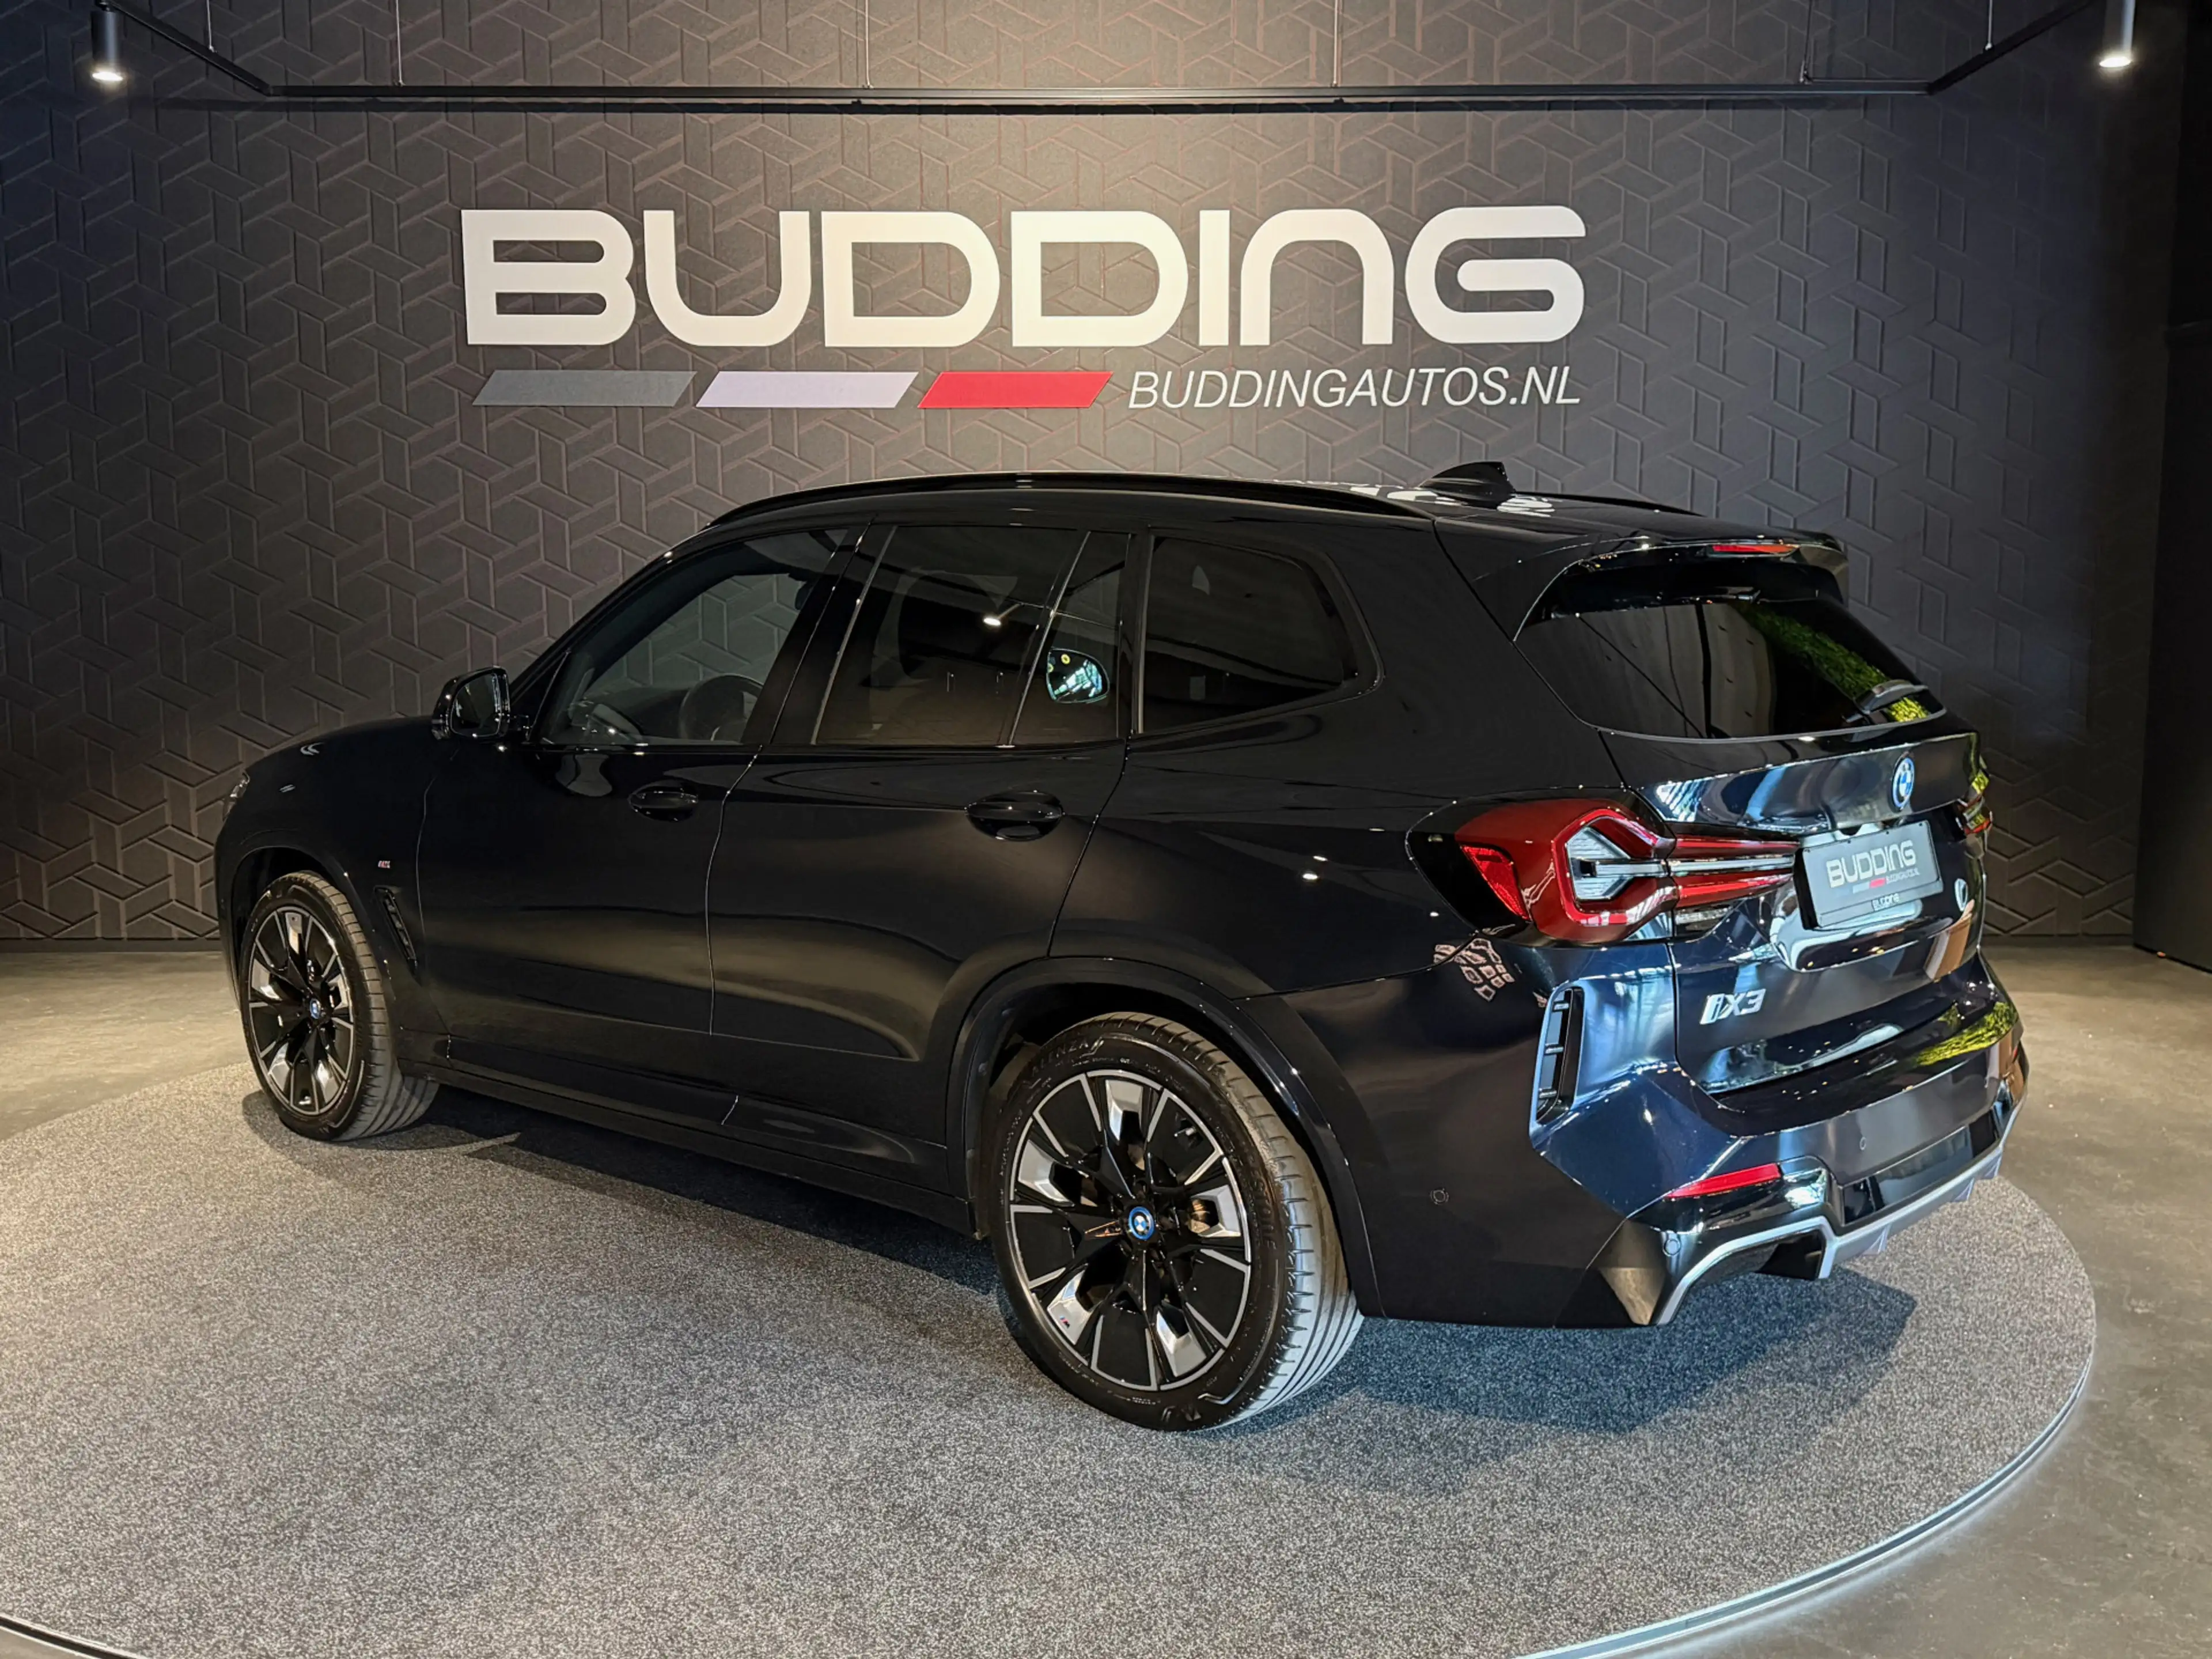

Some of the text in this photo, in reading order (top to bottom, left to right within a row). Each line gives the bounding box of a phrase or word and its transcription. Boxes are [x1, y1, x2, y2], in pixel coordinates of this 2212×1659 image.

[461, 206, 1586, 346] BUDDING
[1128, 366, 1581, 409] BUDDINGAUTOS.NL
[1826, 840, 1916, 888] BUDDING
